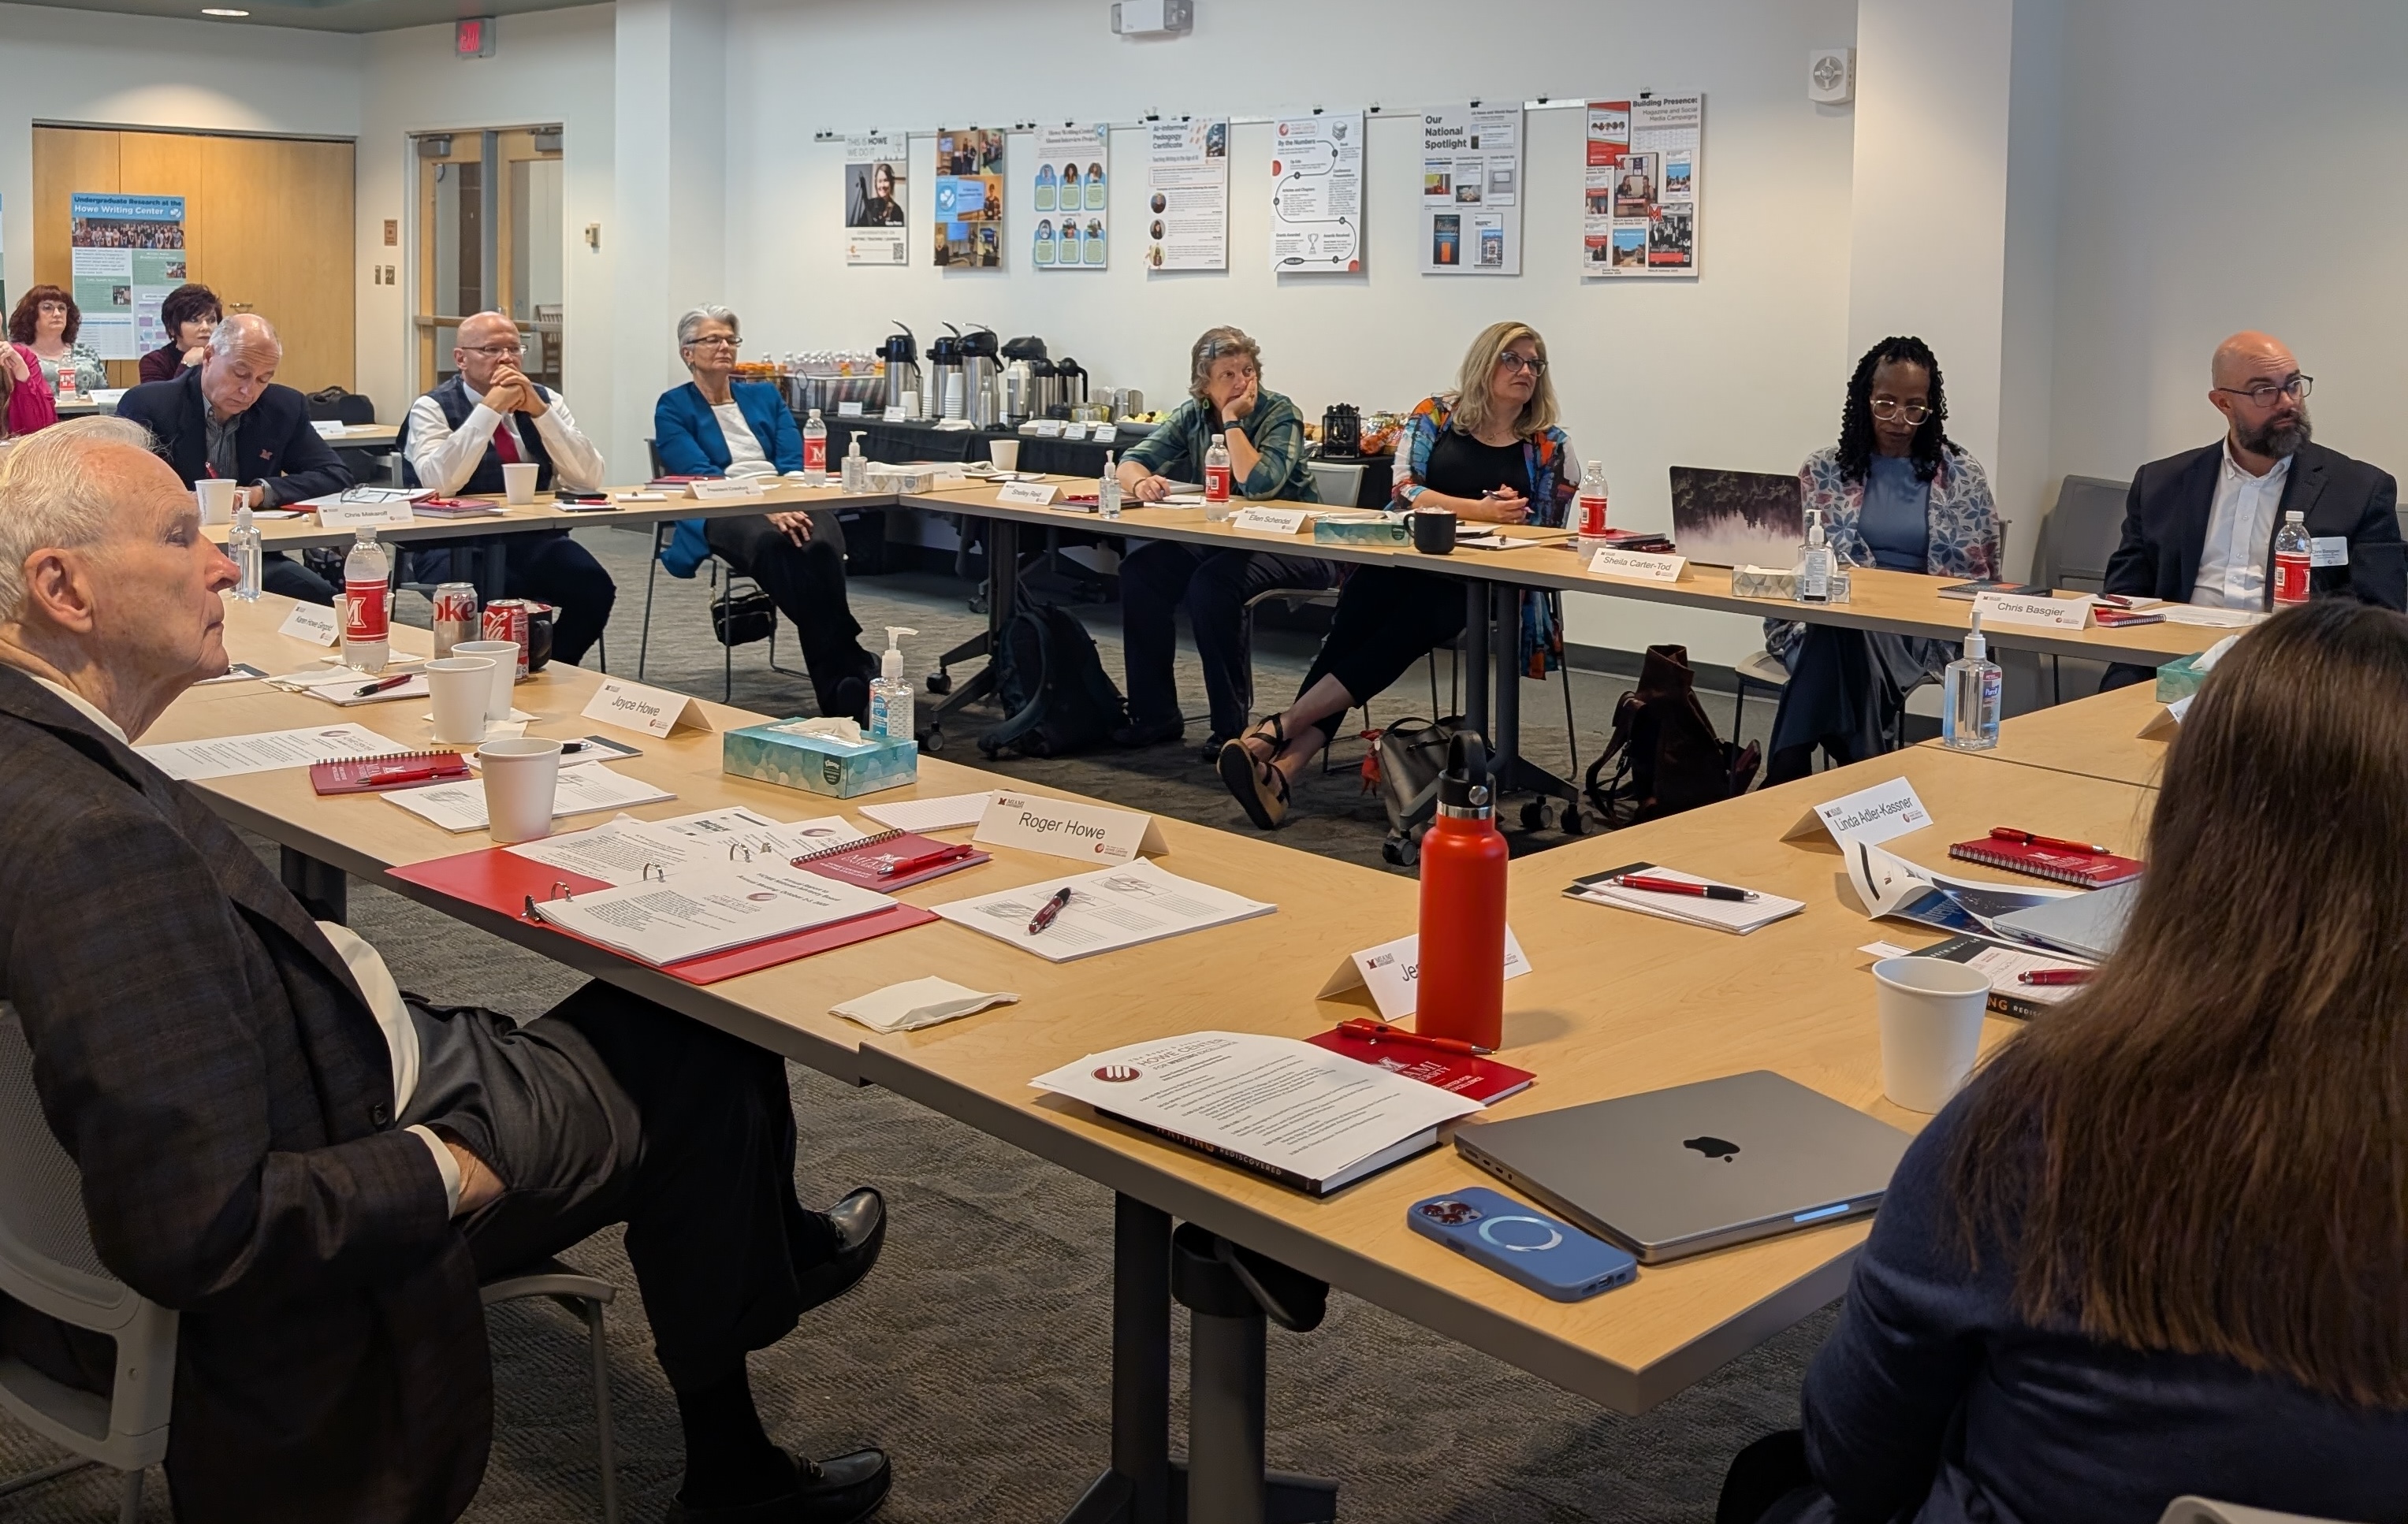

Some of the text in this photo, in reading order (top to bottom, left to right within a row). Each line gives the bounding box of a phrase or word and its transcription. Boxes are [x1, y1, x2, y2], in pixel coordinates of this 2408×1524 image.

[1425, 116, 1442, 125] Our
[1425, 126, 1463, 136] National
[1424, 139, 1467, 151] Spotlight
[74, 196, 127, 205] Undergraduate
[102, 206, 133, 215] Writing
[1264, 516, 1292, 525] Schendel
[1603, 556, 1672, 571] Sheila Carter-Tod
[346, 597, 367, 628] M
[1997, 602, 2065, 617] Chris Basgier
[307, 619, 318, 628] Howe
[612, 695, 661, 716] Joyce Howe
[1834, 814, 1861, 831] Linda
[1858, 797, 1914, 824] Adler-Kassner
[1018, 812, 1106, 840] Roger Howe
[775, 879, 798, 889] National
[797, 885, 824, 896] Advisory
[822, 893, 842, 901] Board
[780, 890, 803, 899] October
[803, 883, 822, 891] Report
[1375, 953, 1394, 964] MIAMI
[1137, 1039, 1227, 1067] HOWE CENTER
[1145, 1048, 1169, 1057] Roger
[1167, 1053, 1199, 1065] WRITING
[1197, 1041, 1239, 1056] EXCELLENCE
[1403, 1061, 1442, 1078] AMI
[1418, 1066, 1451, 1081] ERSITY
[1219, 1147, 1282, 1176] REDISCOVERED
